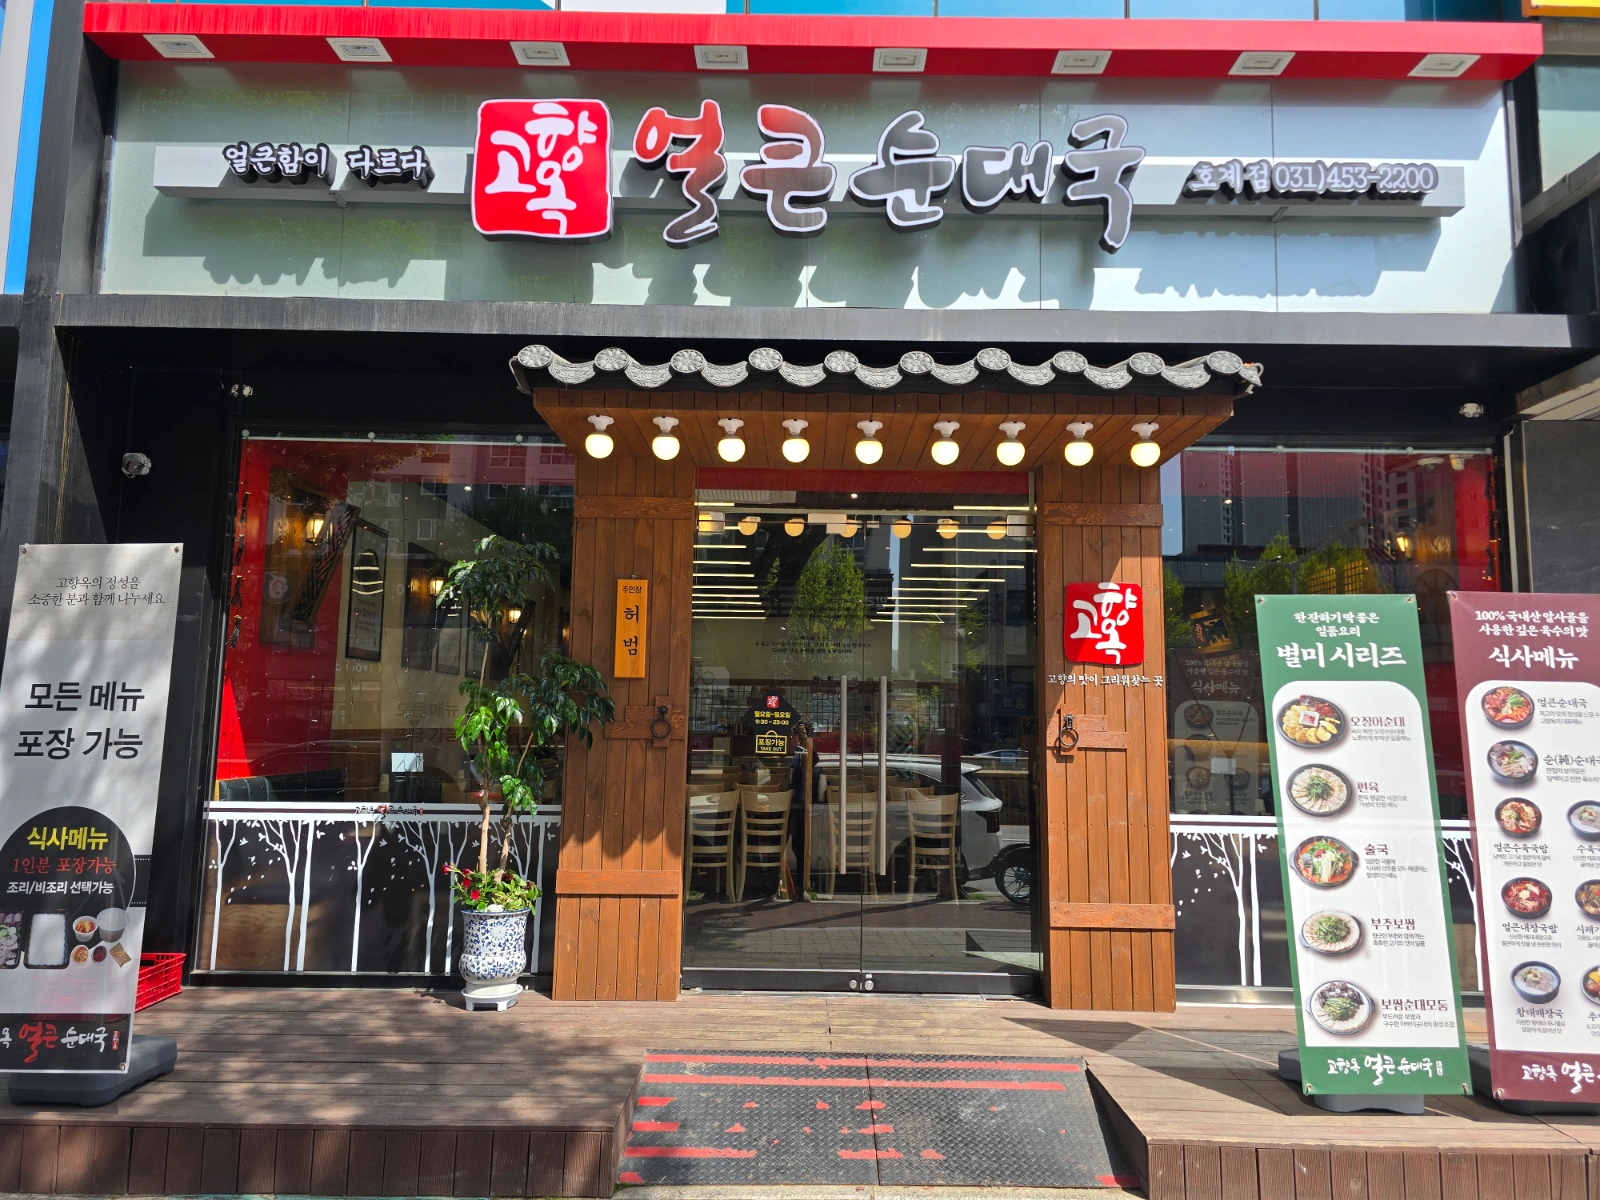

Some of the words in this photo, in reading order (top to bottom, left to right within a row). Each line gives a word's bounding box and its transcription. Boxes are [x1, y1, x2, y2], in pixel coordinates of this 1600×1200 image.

[223, 142, 328, 179] 얼큰함이
[346, 146, 429, 180] 다르다
[1188, 159, 1270, 195] 호계점
[1271, 160, 1438, 196] 031)453-2200
[55, 576, 102, 590] 고향옥의
[105, 576, 141, 590] 정성을
[28, 592, 63, 606] 소중한
[66, 592, 89, 606] 분과
[92, 592, 115, 606] 함께
[117, 592, 165, 606] 나누세요
[1070, 582, 1138, 665] 고향옥
[1475, 610, 1506, 621] 100%
[1506, 610, 1541, 623] 국내산
[1316, 625, 1361, 637] 일품요리
[1479, 623, 1514, 636] 사용한
[1516, 625, 1538, 637] 깊은
[1540, 625, 1575, 638] 육수의
[1576, 626, 1588, 638] 맛
[1276, 642, 1325, 668] 별미
[1329, 642, 1407, 668] 시리즈
[1488, 644, 1579, 670] 식사메뉴
[1047, 673, 1076, 686] 고향의
[1078, 674, 1098, 687] 맛이
[1153, 675, 1164, 687] 곳
[25, 681, 82, 712] 모든
[89, 681, 145, 712] 메뉴
[1537, 697, 1587, 709] 얼큰순대국
[1350, 716, 1406, 728] 오징어순대
[14, 727, 75, 760] 포장
[82, 727, 143, 760] 가능
[1357, 781, 1379, 793] 편육
[27, 826, 109, 850] 식사메뉴
[1364, 843, 1389, 855] 술국
[1494, 842, 1549, 854] 얼큰수육국밥
[13, 856, 51, 875] 1인분
[56, 855, 117, 875] 포장가능
[6, 880, 68, 895] 조리/비조리
[70, 880, 115, 895] 선택가능
[1371, 918, 1415, 930] 부추보쌈
[1502, 921, 1558, 934] 얼큰내장국밥
[1381, 998, 1448, 1011] 보쌈순대모둠
[1516, 1006, 1564, 1018] 황태해장국
[19, 1021, 58, 1063] 얼큰
[61, 1026, 108, 1052] 순대국
[1327, 1057, 1361, 1075] 고향옥
[1364, 1053, 1396, 1086] 얼큰
[1397, 1057, 1433, 1077] 순대국
[1522, 1063, 1557, 1081] 고향옥
[1561, 1060, 1595, 1093] 얼큰
